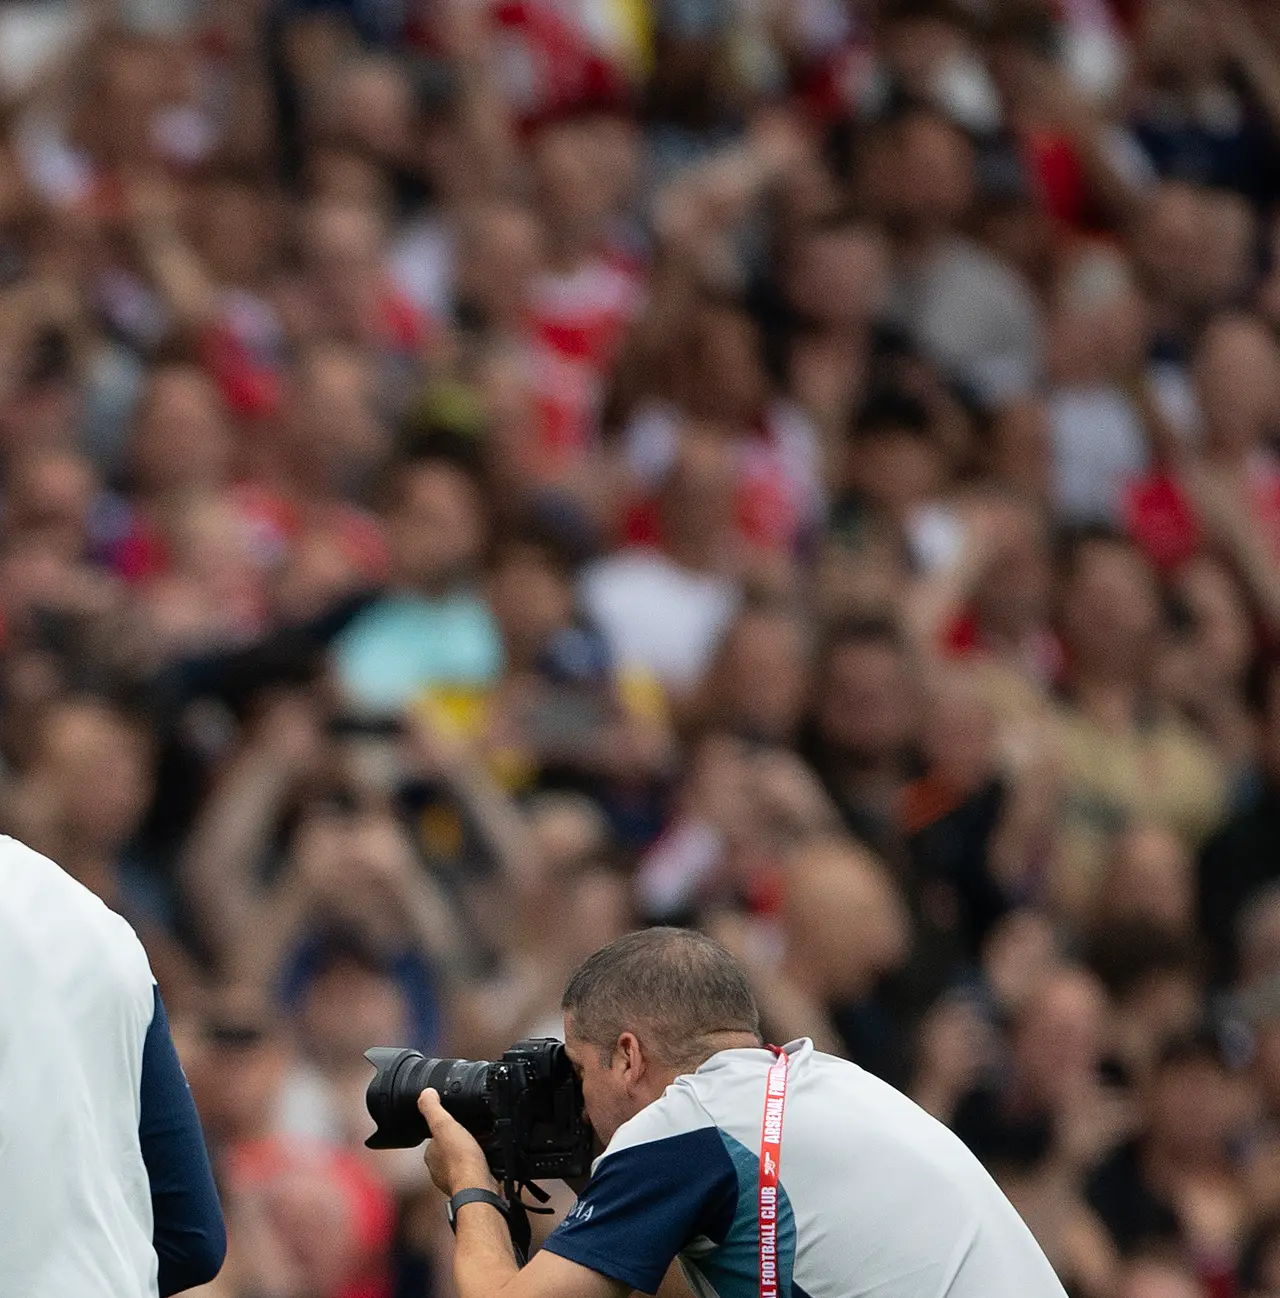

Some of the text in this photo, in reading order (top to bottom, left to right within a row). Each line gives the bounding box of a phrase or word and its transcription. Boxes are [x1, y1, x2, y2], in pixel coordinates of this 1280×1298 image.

[763, 1097, 784, 1144] ARSENAL
[760, 1186, 777, 1219] CLUB
[761, 1222, 777, 1286] FOOTBALL
